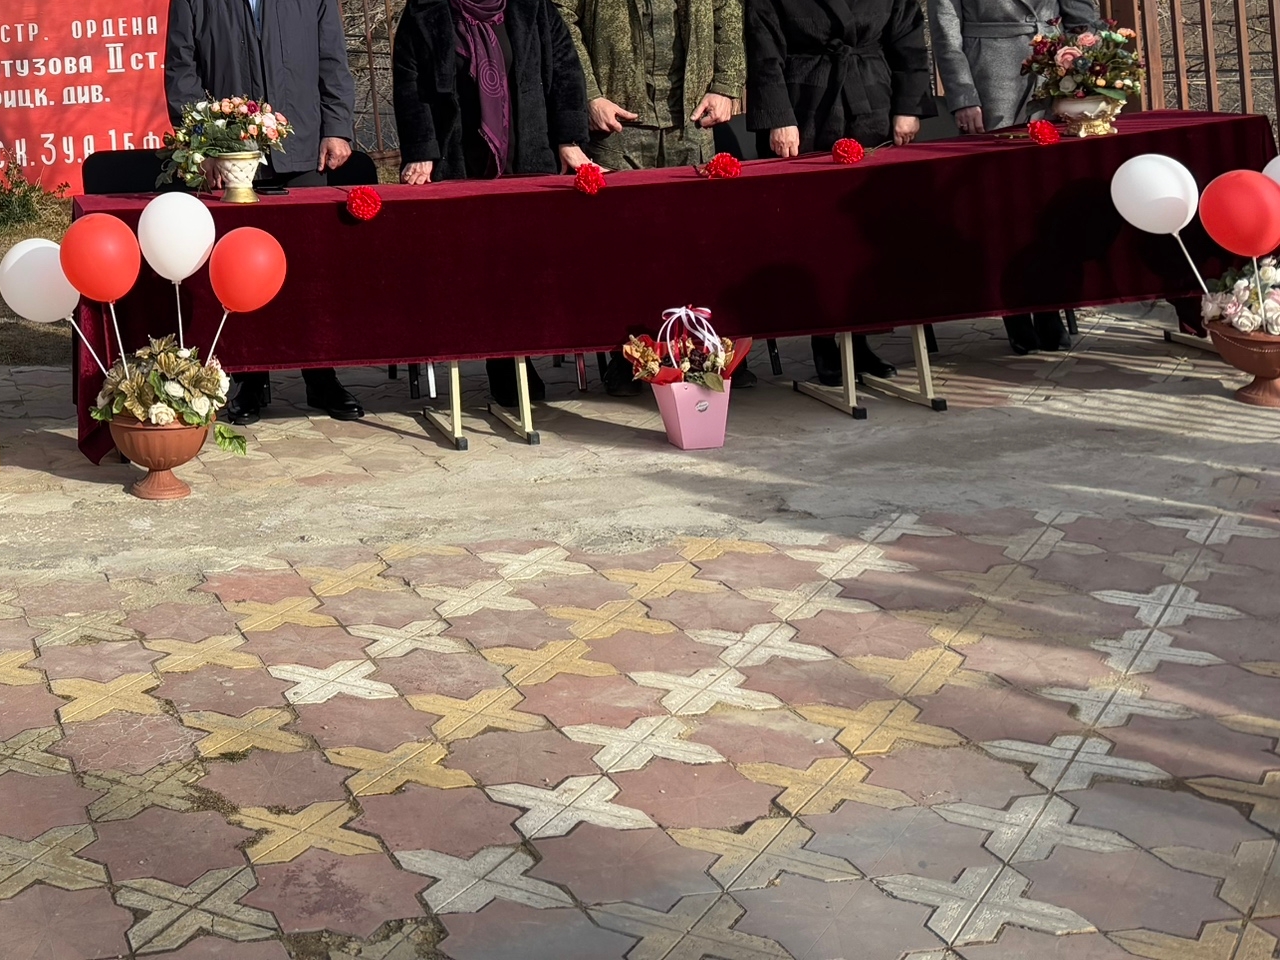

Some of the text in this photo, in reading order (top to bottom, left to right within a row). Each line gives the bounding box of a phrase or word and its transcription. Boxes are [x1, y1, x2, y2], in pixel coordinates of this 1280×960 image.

[0, 23, 49, 43] СТР.
[71, 16, 158, 39] ОРДЕНА
[62, 84, 110, 105] ДИВ.
